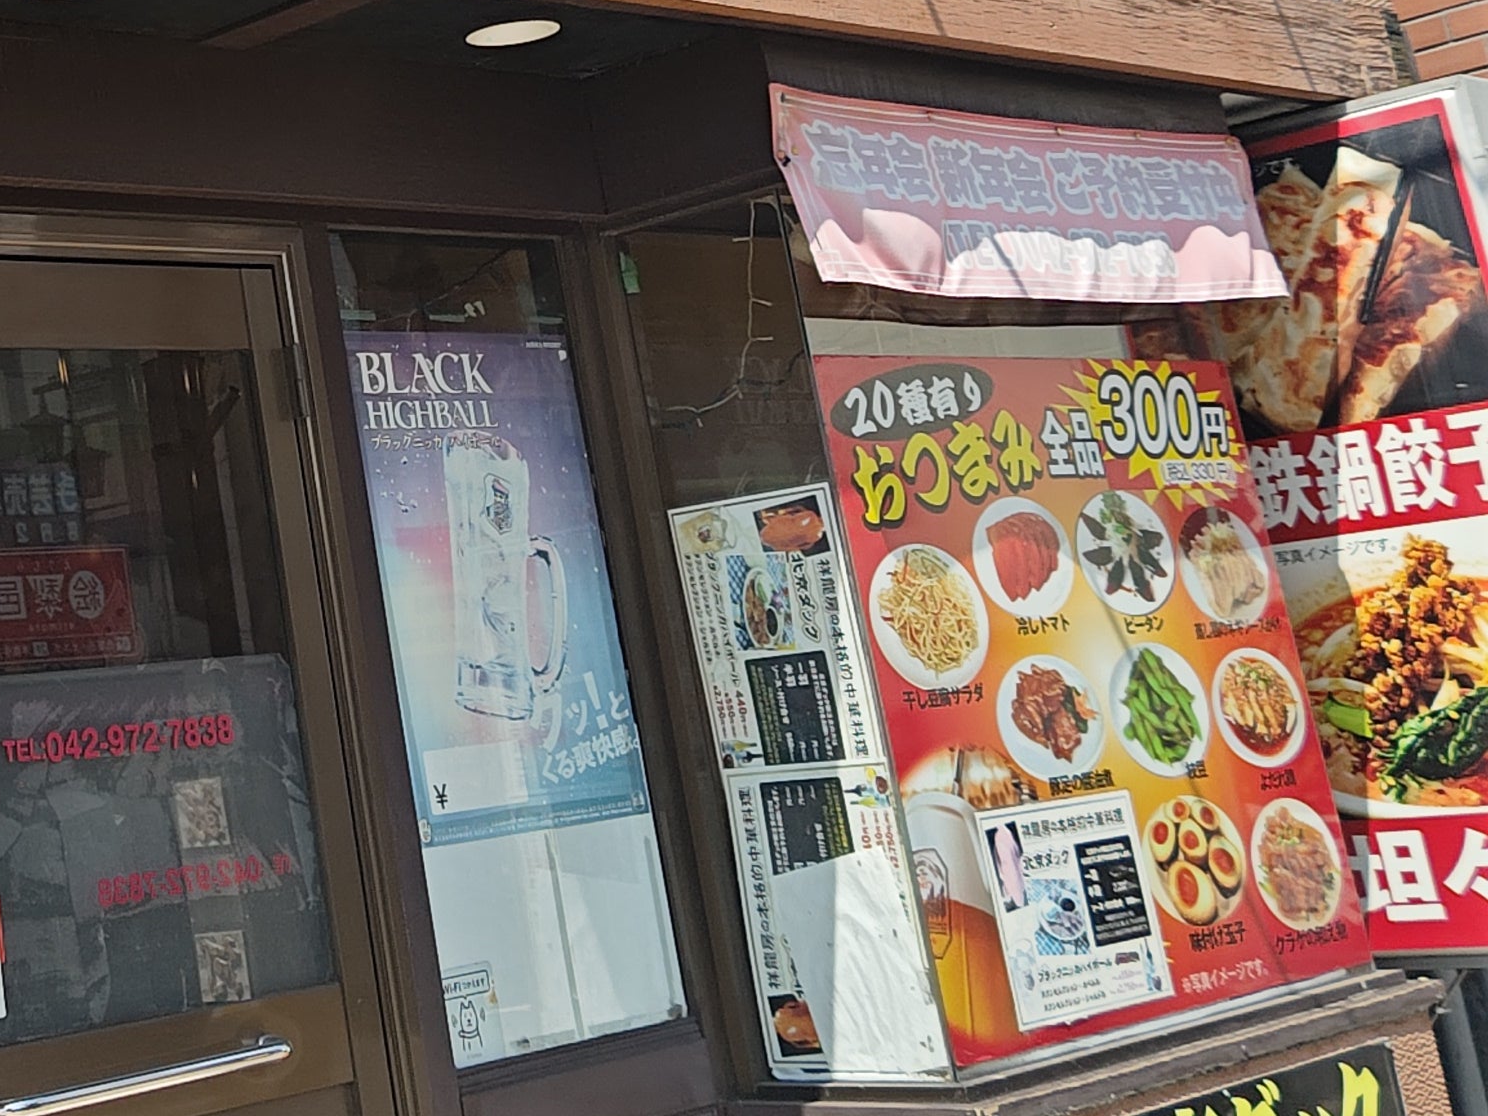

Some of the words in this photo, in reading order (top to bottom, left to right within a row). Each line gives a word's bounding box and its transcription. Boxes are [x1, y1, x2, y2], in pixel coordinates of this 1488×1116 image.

[356, 352, 493, 395] BLACK
[365, 400, 499, 430] HIGHBALL
[844, 372, 983, 438] 20種有り
[1040, 409, 1105, 478] 全品
[1099, 372, 1230, 459] 300円
[853, 410, 1042, 524] おつまみ
[1015, 614, 1070, 636] 冷しトマト
[902, 682, 985, 710] 干し豆腐サラダ
